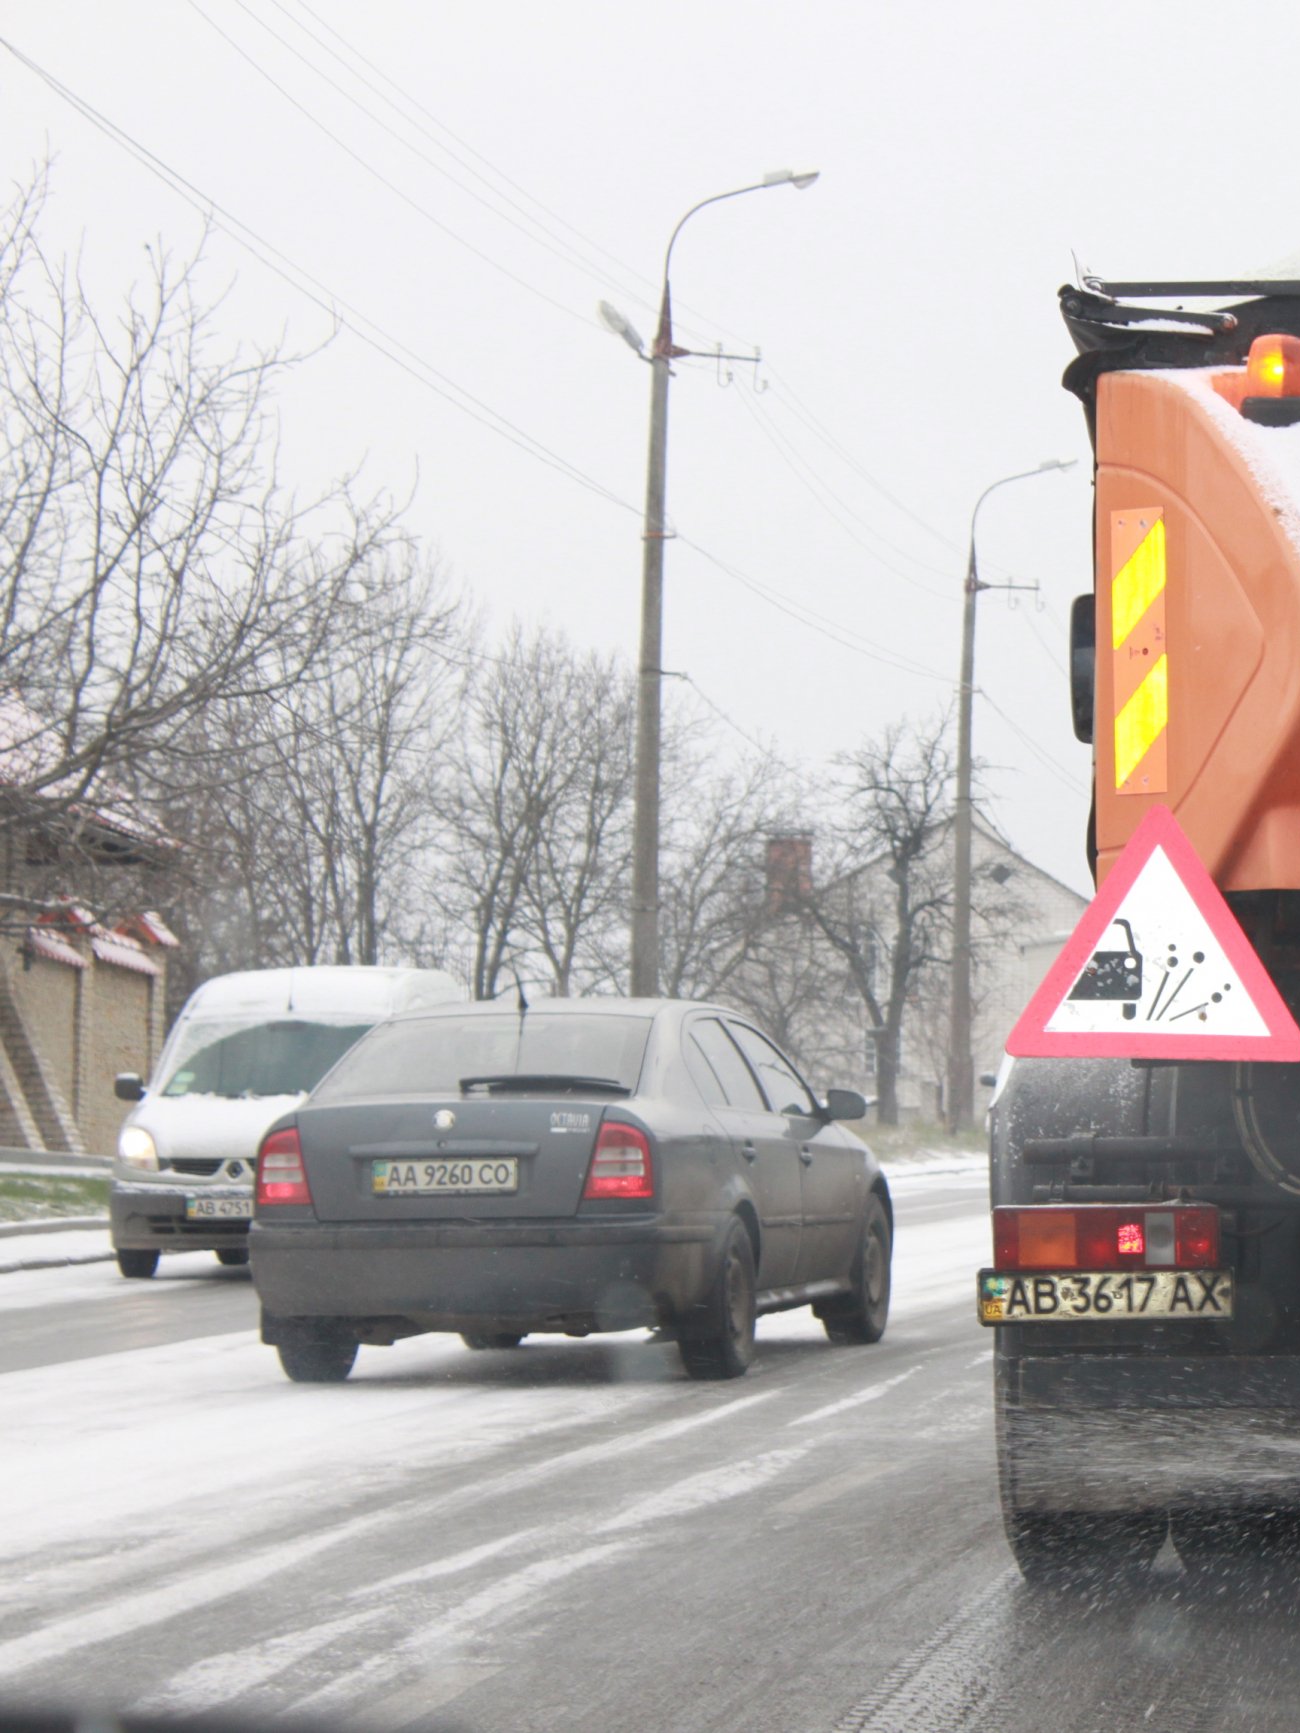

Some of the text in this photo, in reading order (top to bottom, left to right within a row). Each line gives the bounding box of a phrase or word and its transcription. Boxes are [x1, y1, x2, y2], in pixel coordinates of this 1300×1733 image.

[388, 1163, 510, 1187] AA 9260 CO
[197, 1201, 250, 1215] AB 4751
[1006, 1275, 1223, 1315] AB 3617 AX
